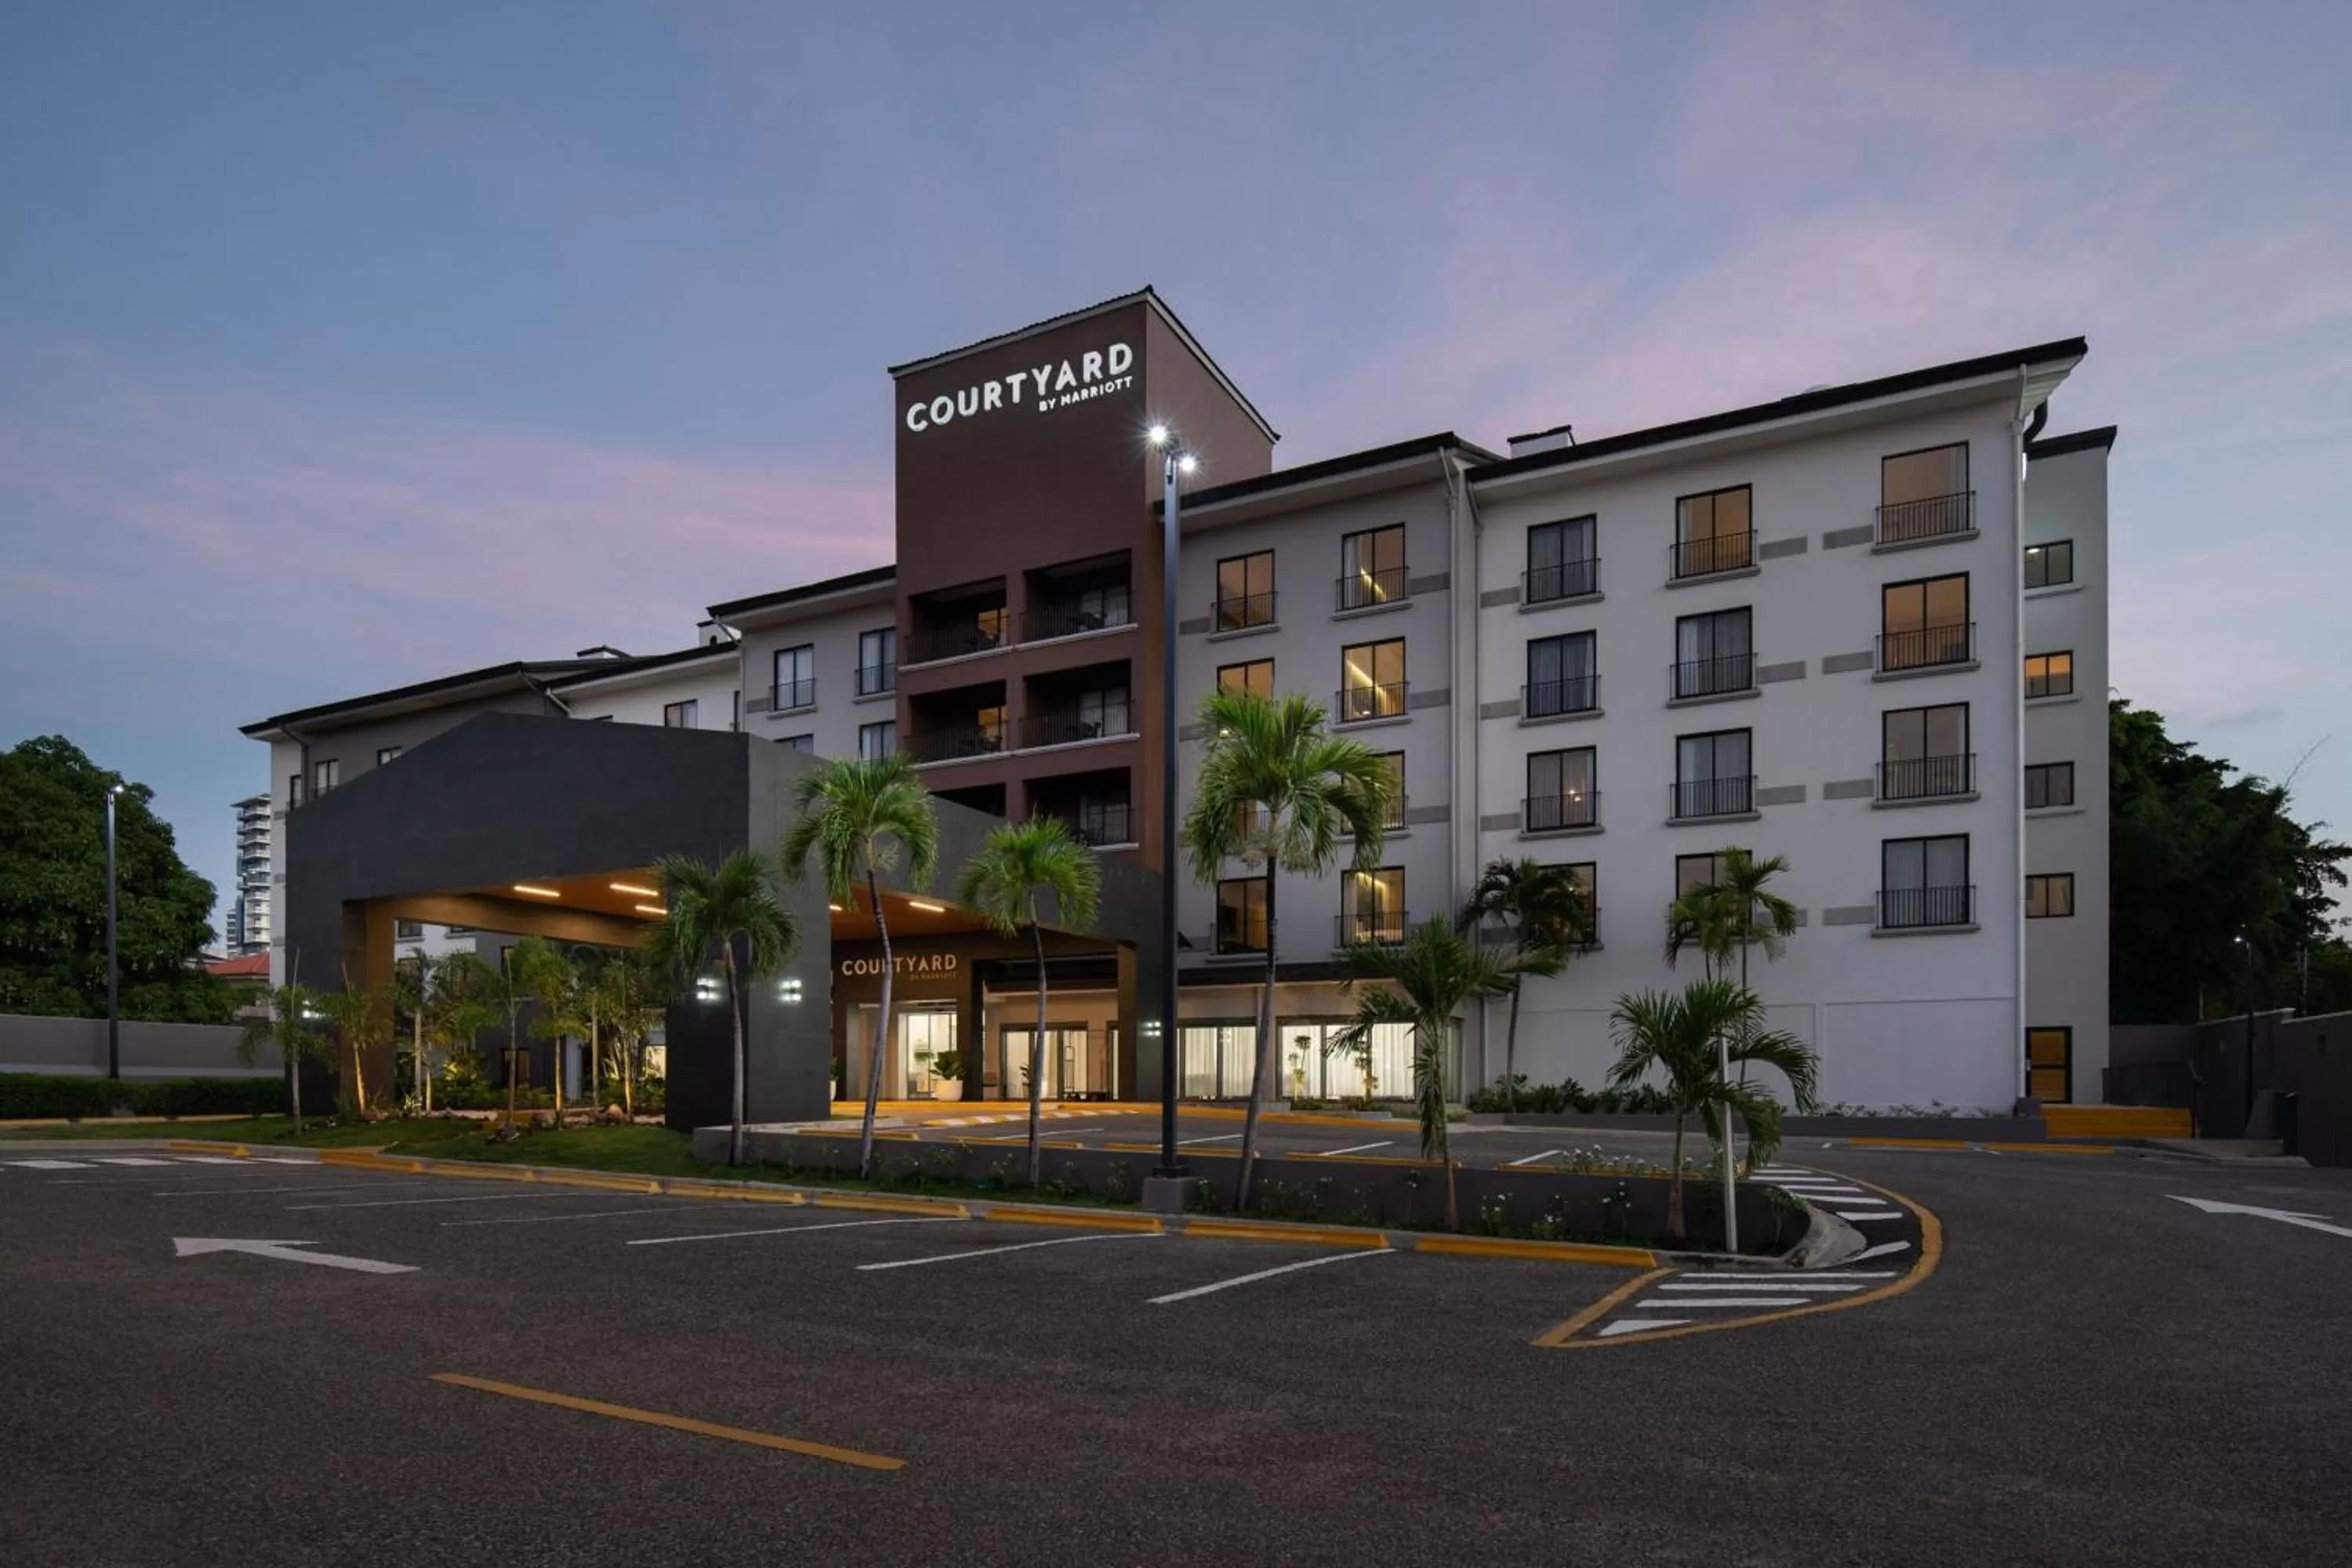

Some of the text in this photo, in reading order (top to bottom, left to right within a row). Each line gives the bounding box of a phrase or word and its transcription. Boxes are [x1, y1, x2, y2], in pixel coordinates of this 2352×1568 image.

[906, 343, 1133, 432] COURTYARD
[1039, 376, 1133, 412] BY MARRIOTT
[841, 954, 956, 975] COUTYARD
